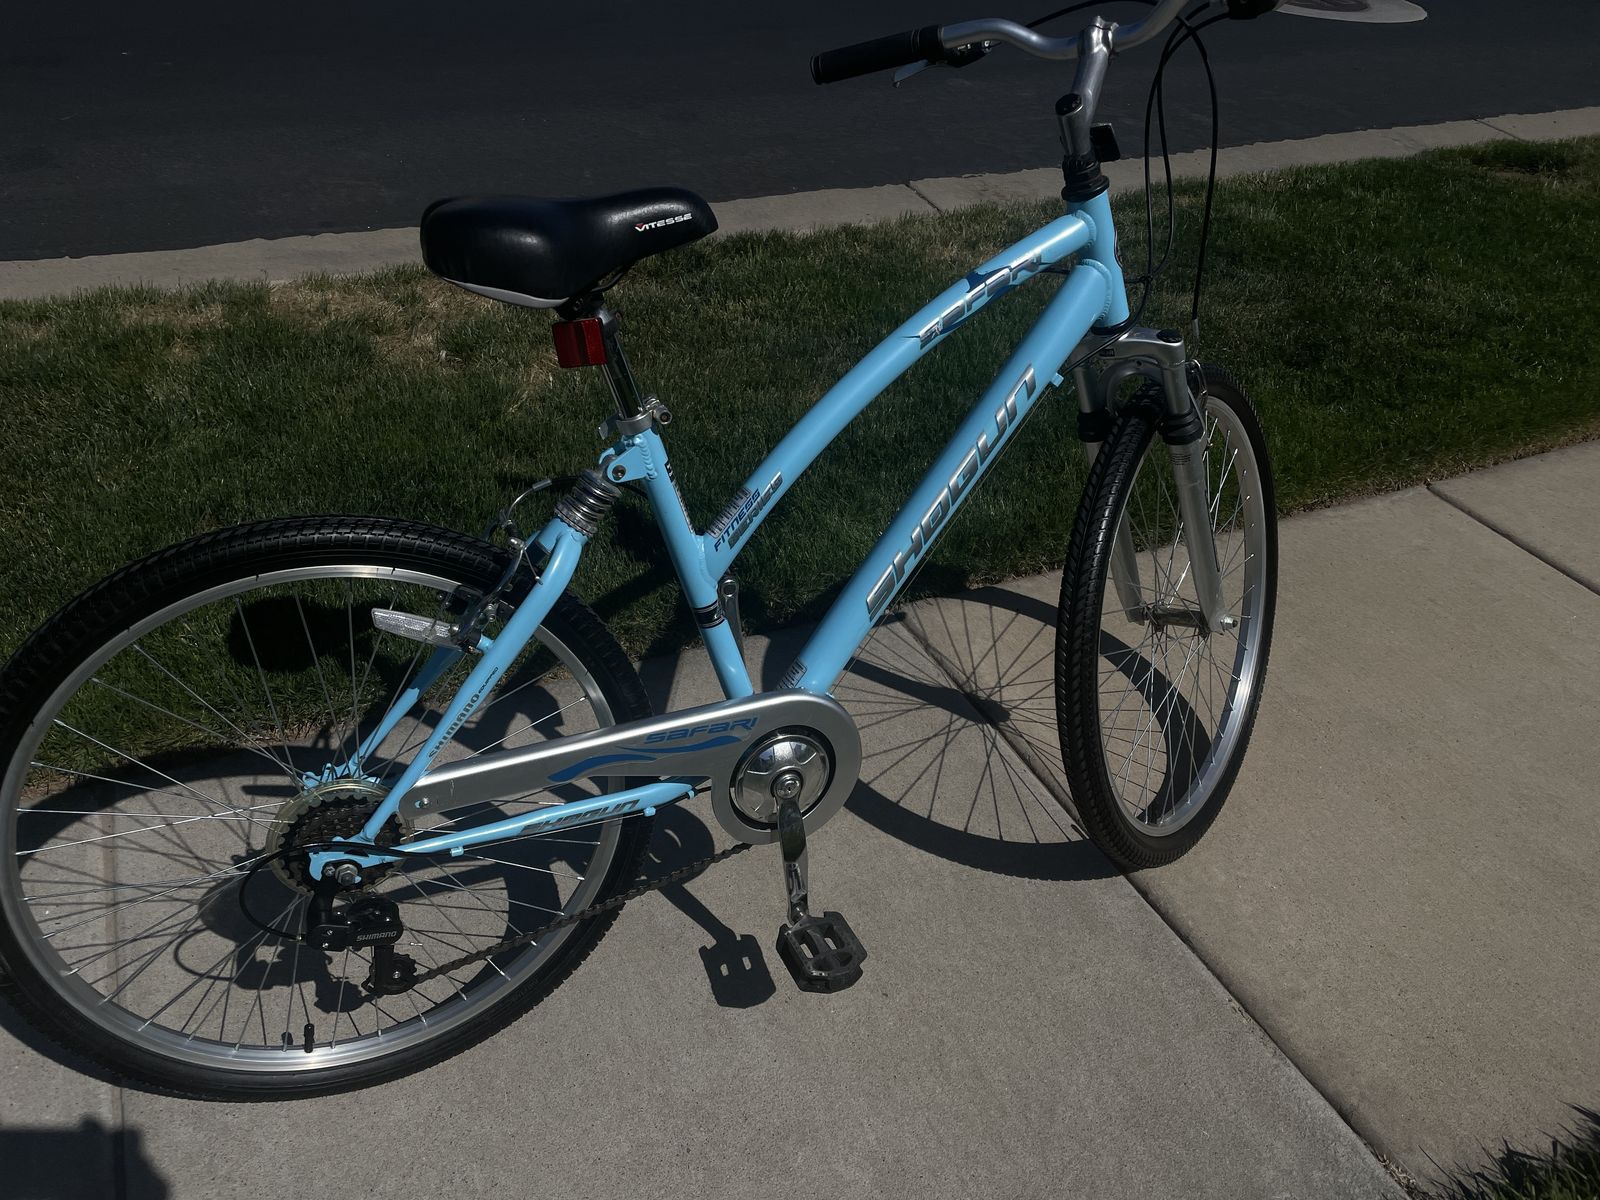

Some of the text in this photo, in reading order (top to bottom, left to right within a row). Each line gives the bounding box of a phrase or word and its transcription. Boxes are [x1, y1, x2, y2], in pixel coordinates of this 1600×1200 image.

[634, 213, 693, 232] VITESSE
[865, 363, 1037, 623] SHOGUN
[713, 488, 761, 552] FITNESS
[428, 693, 480, 758] SHIMANO
[644, 717, 758, 745] SAFARI
[356, 930, 397, 942] SHIMANO
